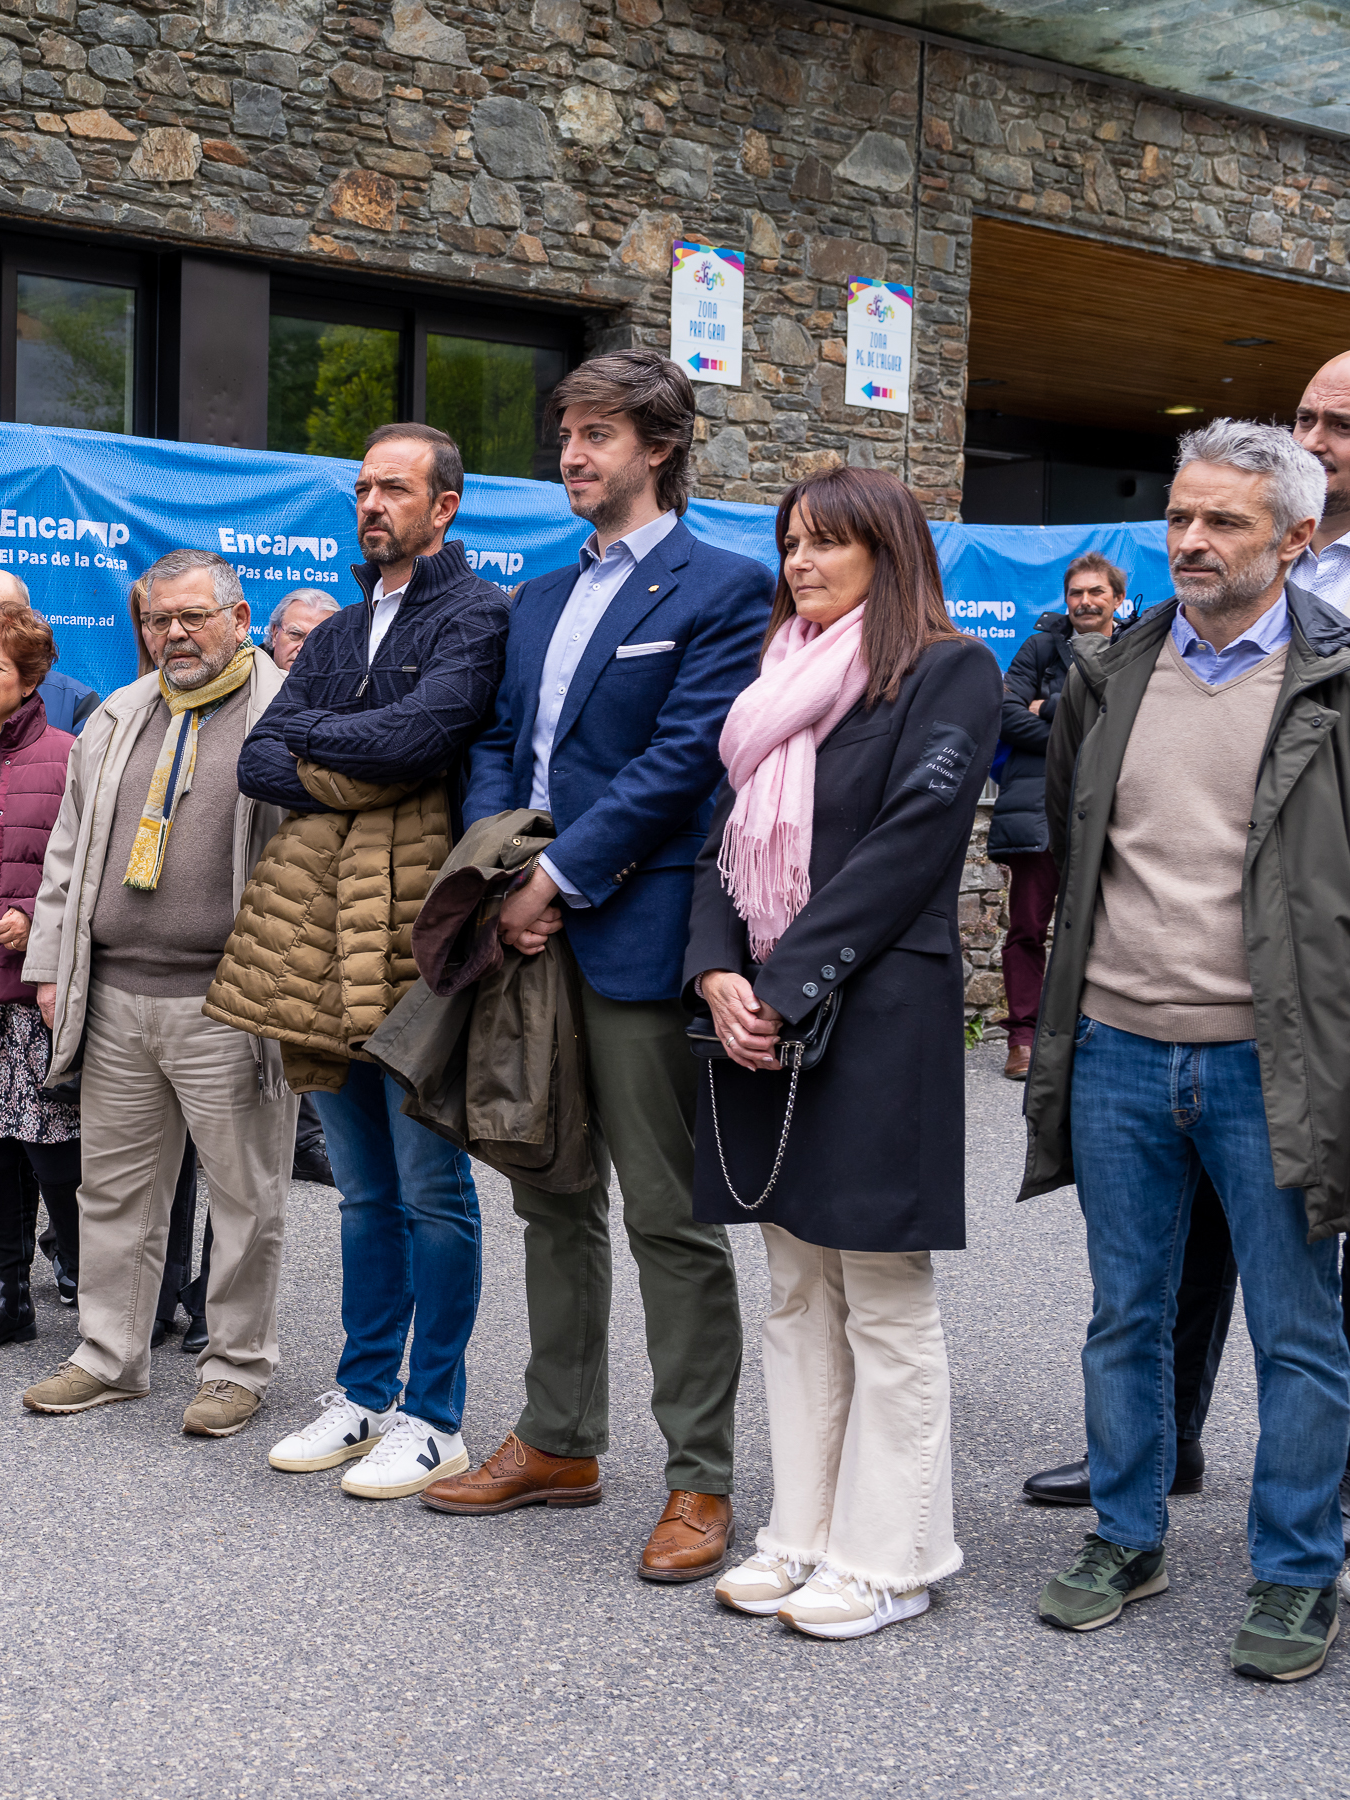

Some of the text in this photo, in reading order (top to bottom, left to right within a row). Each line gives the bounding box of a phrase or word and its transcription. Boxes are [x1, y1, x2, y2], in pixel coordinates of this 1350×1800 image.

[698, 300, 718, 319] ZONA
[689, 320, 725, 341] PRAT GRAN
[870, 331, 888, 350] ZONA
[867, 351, 875, 368] DE
[0, 509, 130, 549] Encamp
[218, 527, 338, 562] Encamp
[18, 549, 48, 565] Pas
[51, 551, 71, 566] de
[74, 552, 90, 567] la
[93, 553, 128, 571] Casa
[465, 549, 524, 576] amp
[236, 564, 261, 579] Pas
[264, 566, 283, 580] de
[286, 566, 301, 581] la
[303, 567, 339, 583] Casa
[944, 600, 1016, 622] ncamp
[44, 614, 115, 628] .encamp.ad
[977, 625, 988, 638] la
[989, 626, 1016, 638] Casa
[936, 754, 955, 768] WITH
[942, 746, 960, 759] LIVE
[925, 762, 954, 779] PASSION
